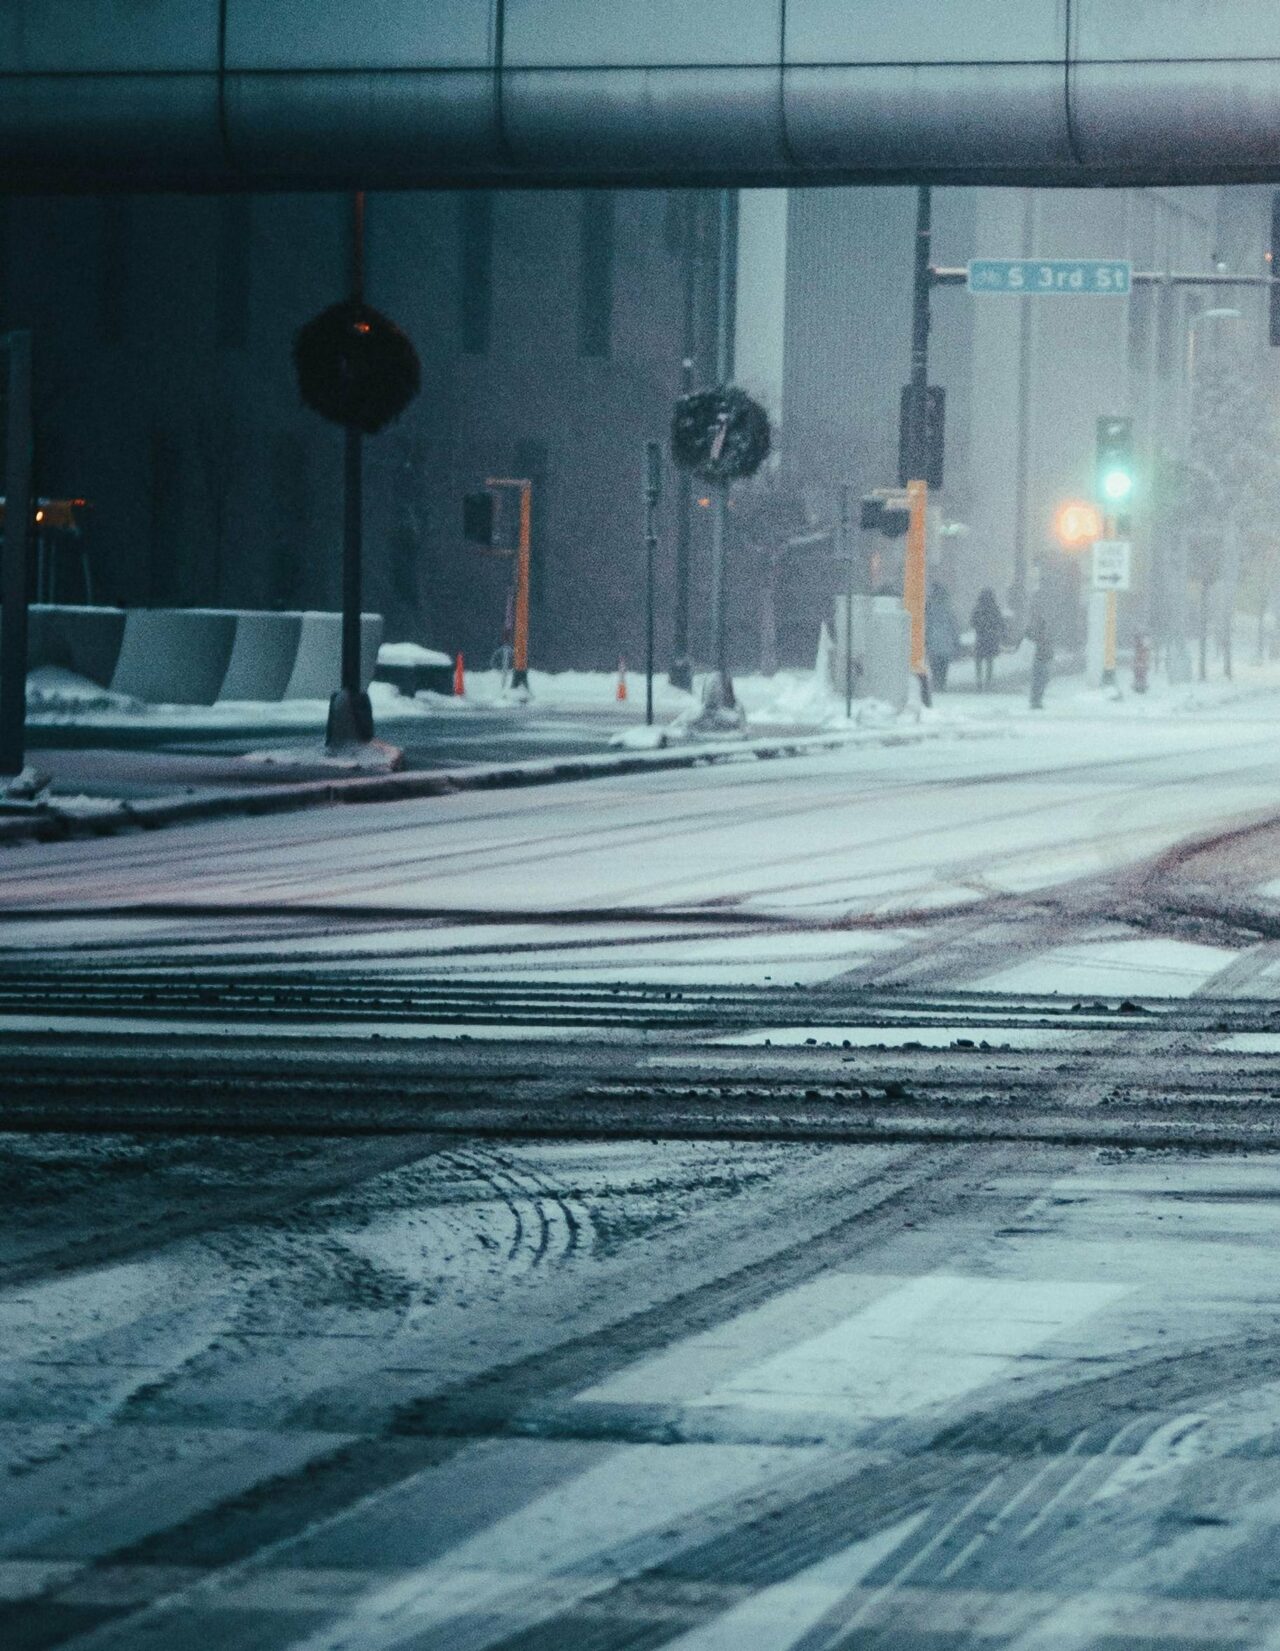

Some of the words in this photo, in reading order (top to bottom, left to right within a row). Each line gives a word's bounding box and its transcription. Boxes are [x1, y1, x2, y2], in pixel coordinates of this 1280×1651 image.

[1008, 266, 1024, 287] S
[1038, 266, 1083, 287] 3rd
[1096, 267, 1124, 287] St
